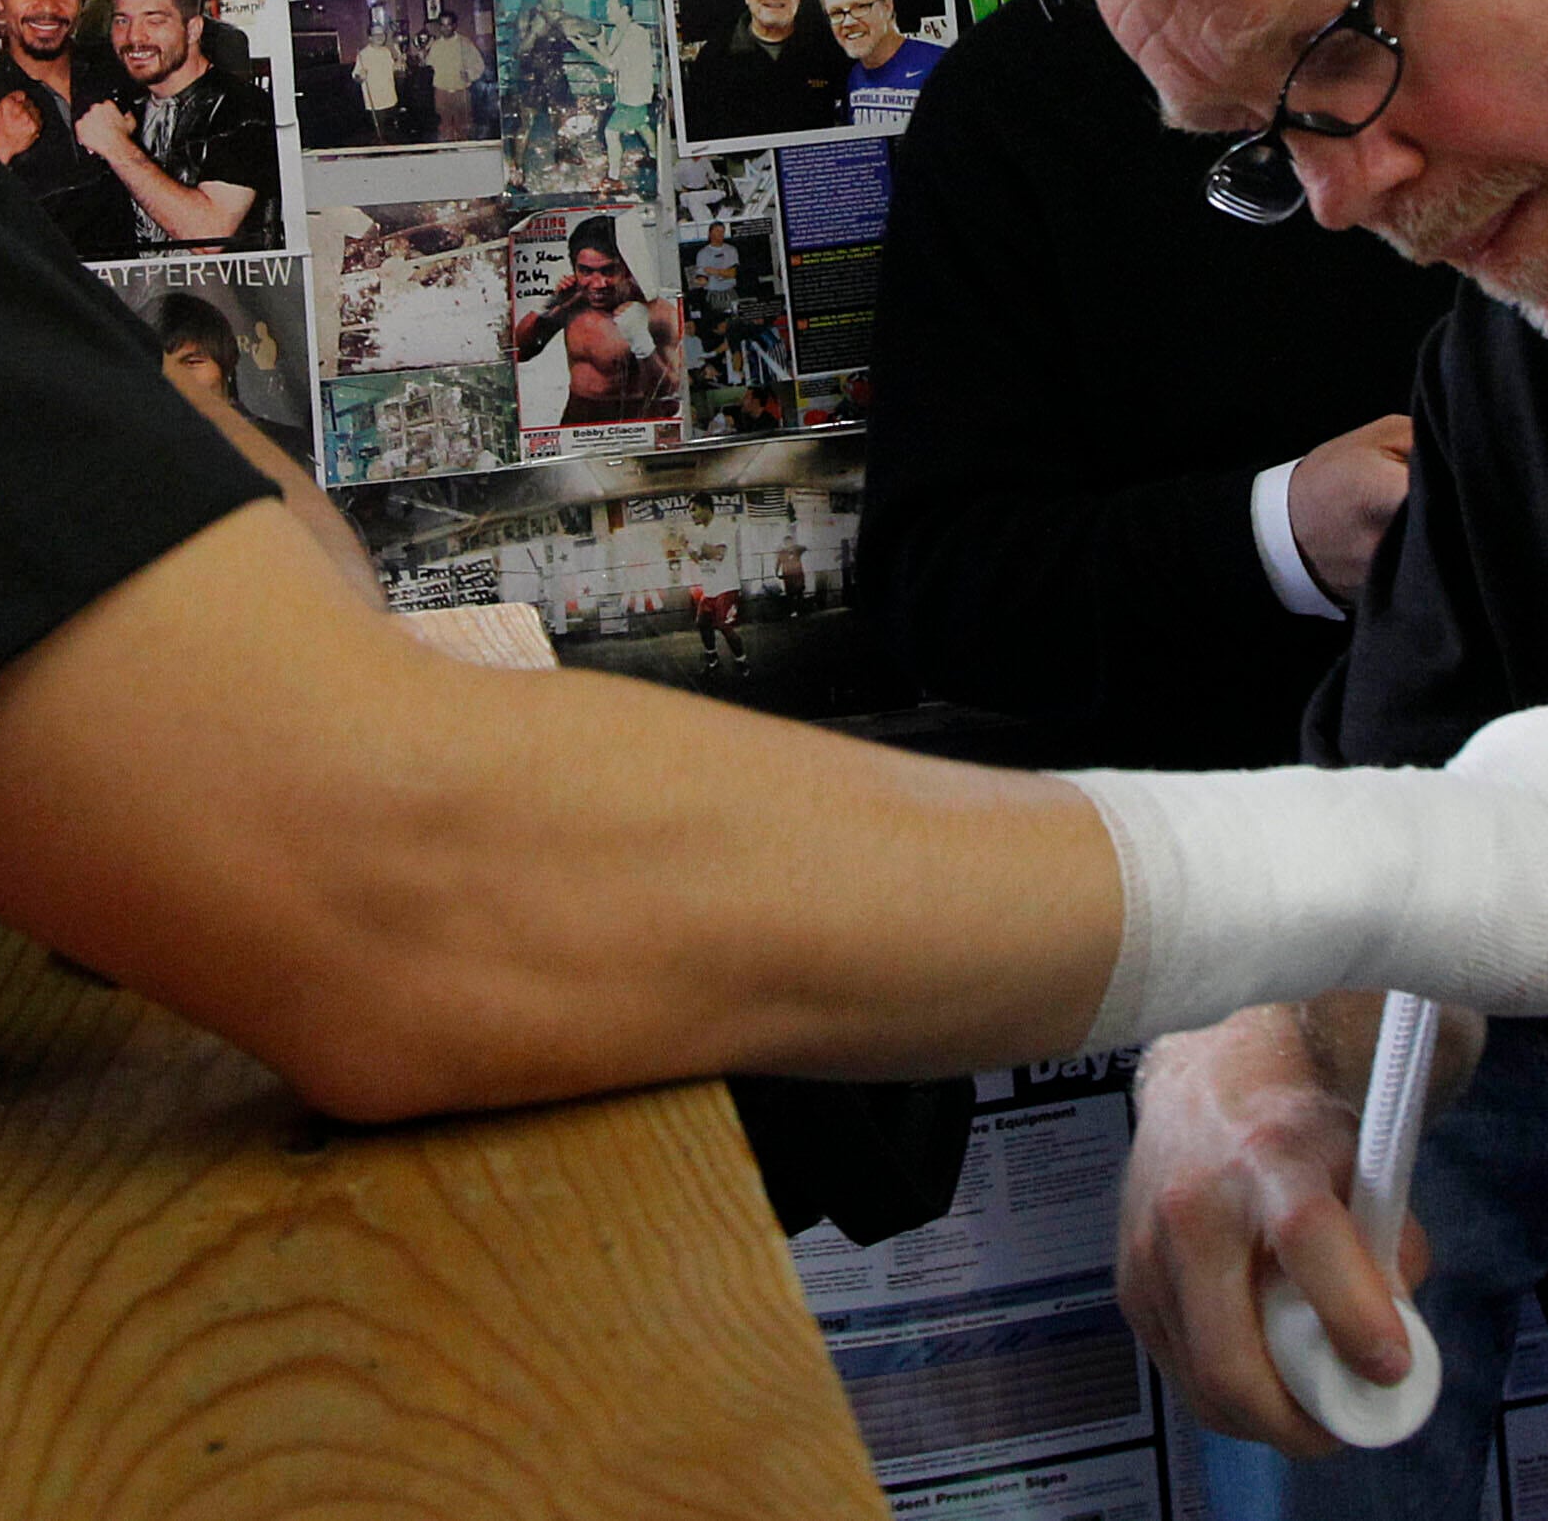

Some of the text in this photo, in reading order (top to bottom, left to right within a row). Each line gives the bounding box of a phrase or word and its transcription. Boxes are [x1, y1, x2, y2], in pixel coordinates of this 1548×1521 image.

[573, 426, 646, 439] Bobby Chacon
[995, 1105, 1077, 1131] Equipment
[935, 1481, 1020, 1505] Prevention
[1026, 1472, 1068, 1489] Signs
